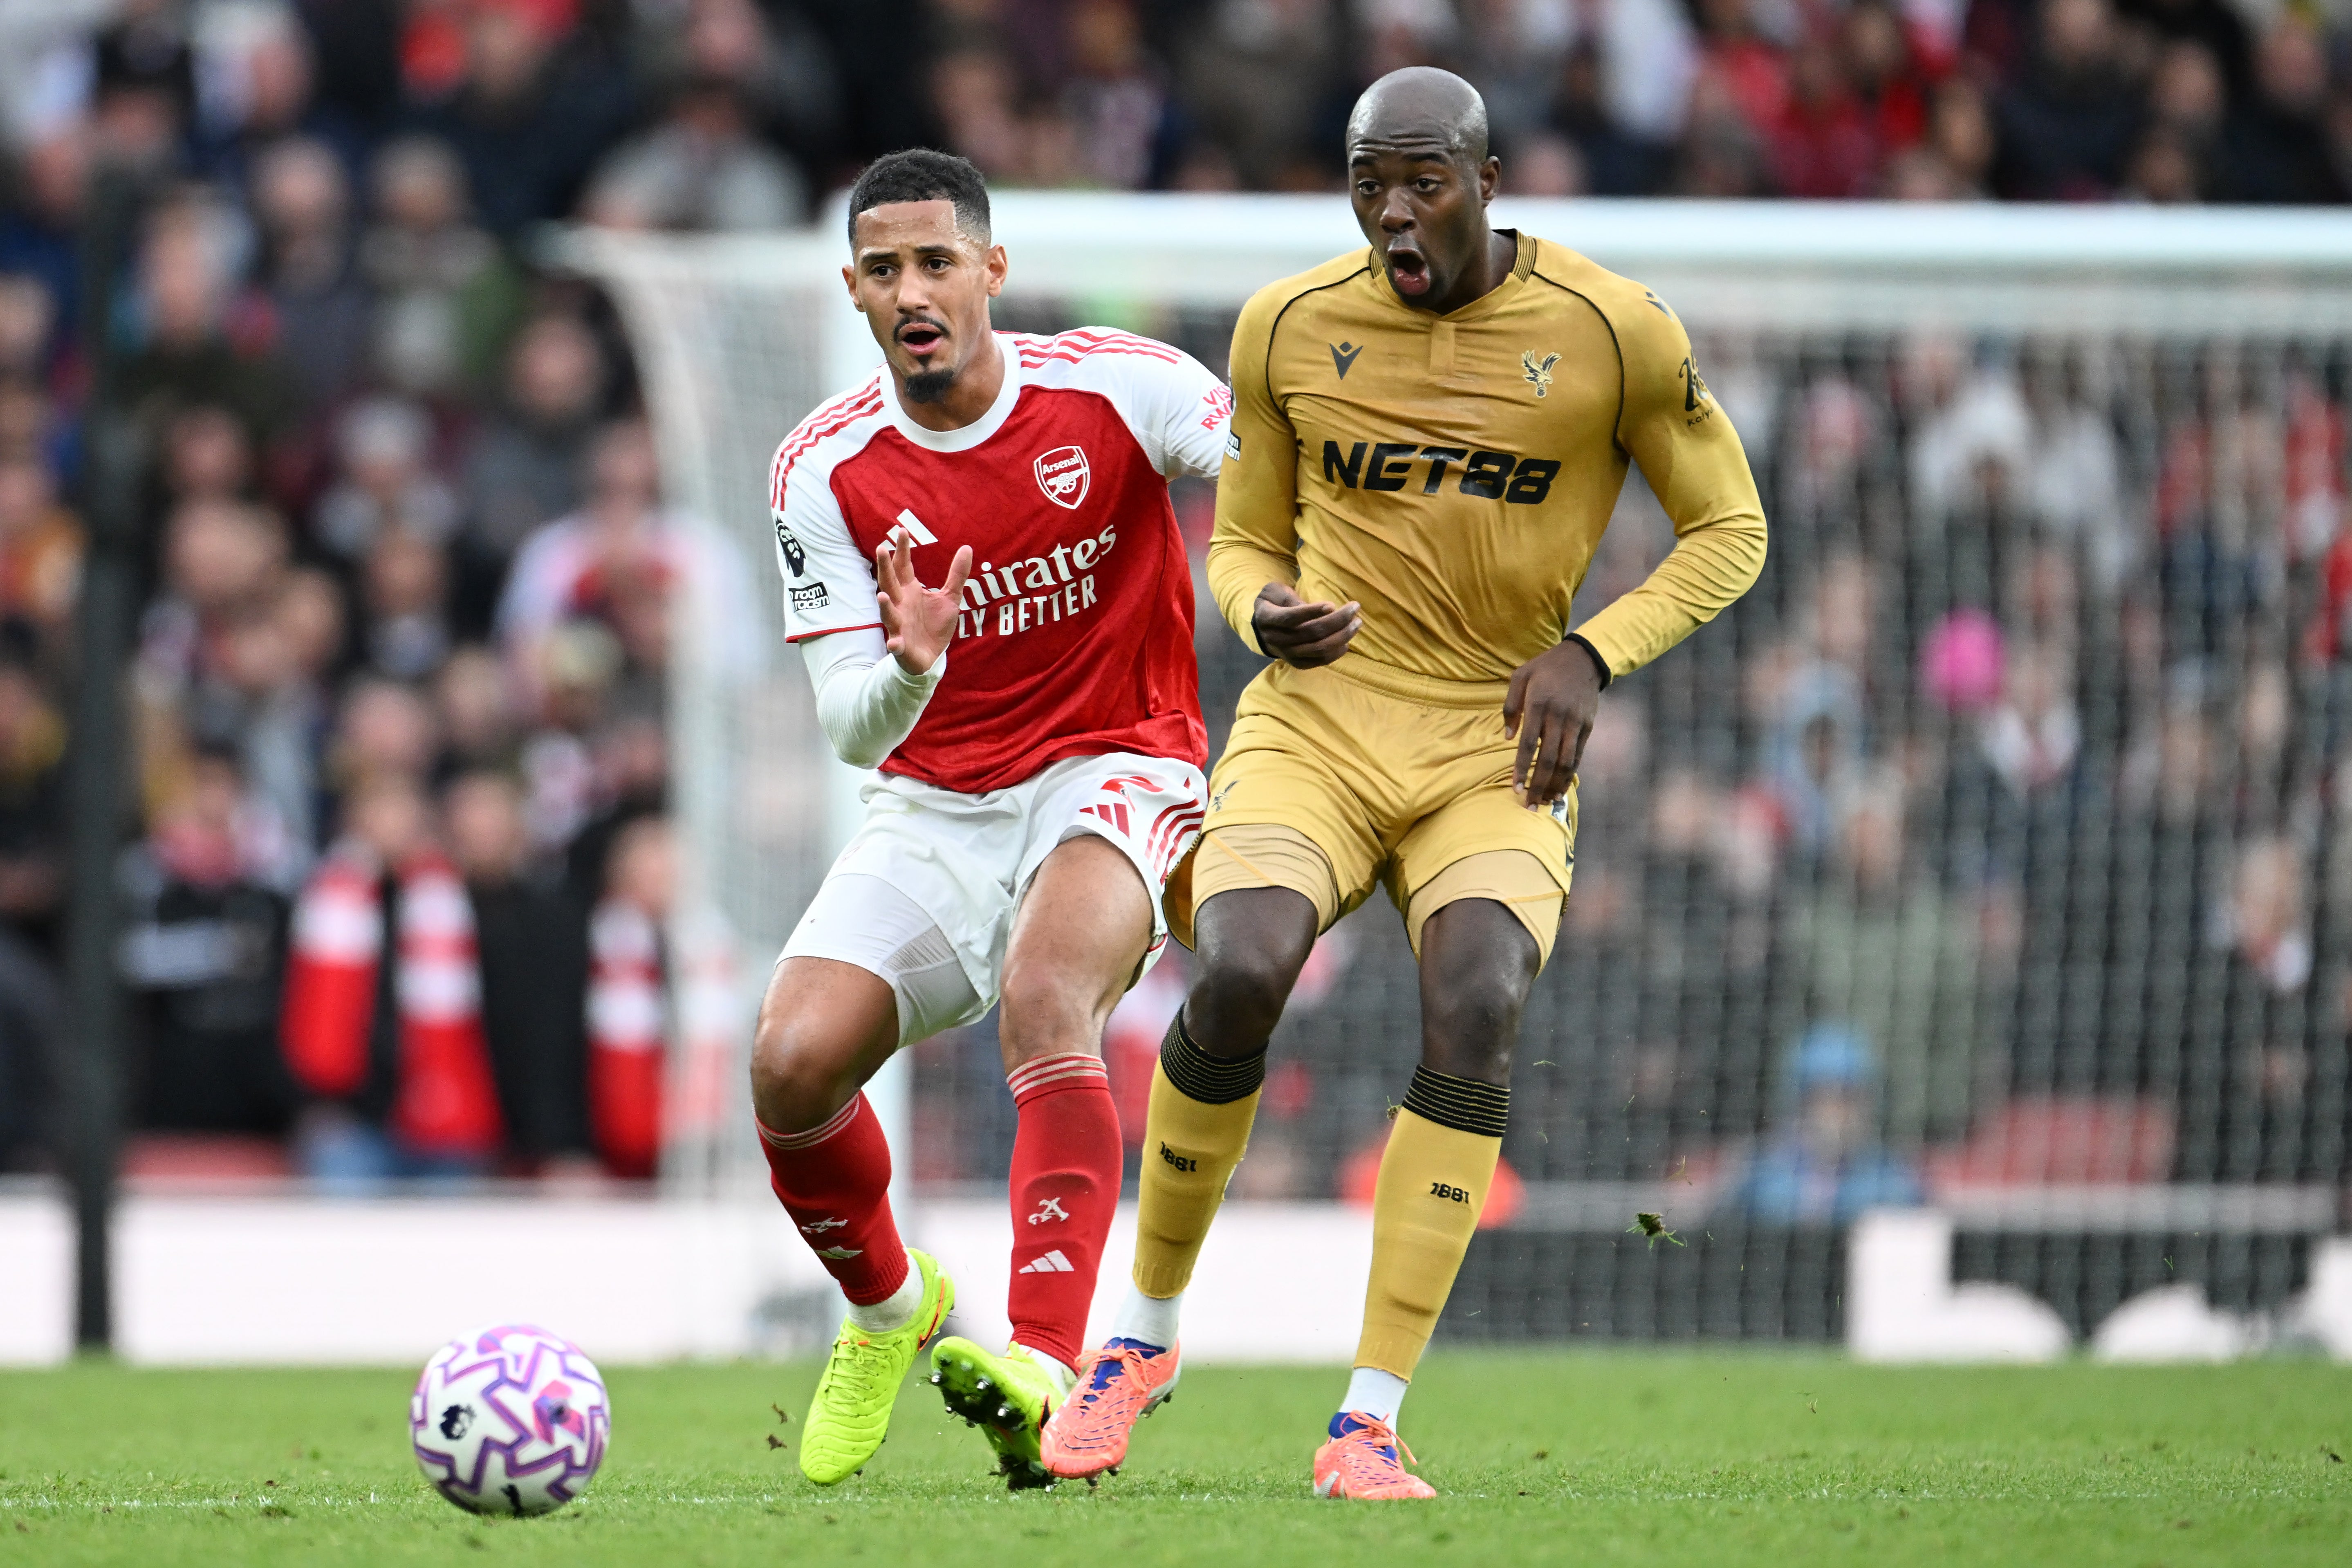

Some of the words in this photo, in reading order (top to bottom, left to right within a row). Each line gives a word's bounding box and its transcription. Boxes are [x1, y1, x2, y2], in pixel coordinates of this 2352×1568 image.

[1043, 454, 1080, 475] Arsenal
[1323, 440, 1561, 505] NET88
[794, 586, 823, 600] room
[794, 595, 830, 611] racism
[959, 608, 986, 639] LY
[999, 574, 1097, 636] BETTER
[1160, 1141, 1197, 1172] 1881
[1430, 1182, 1469, 1205] 1881
